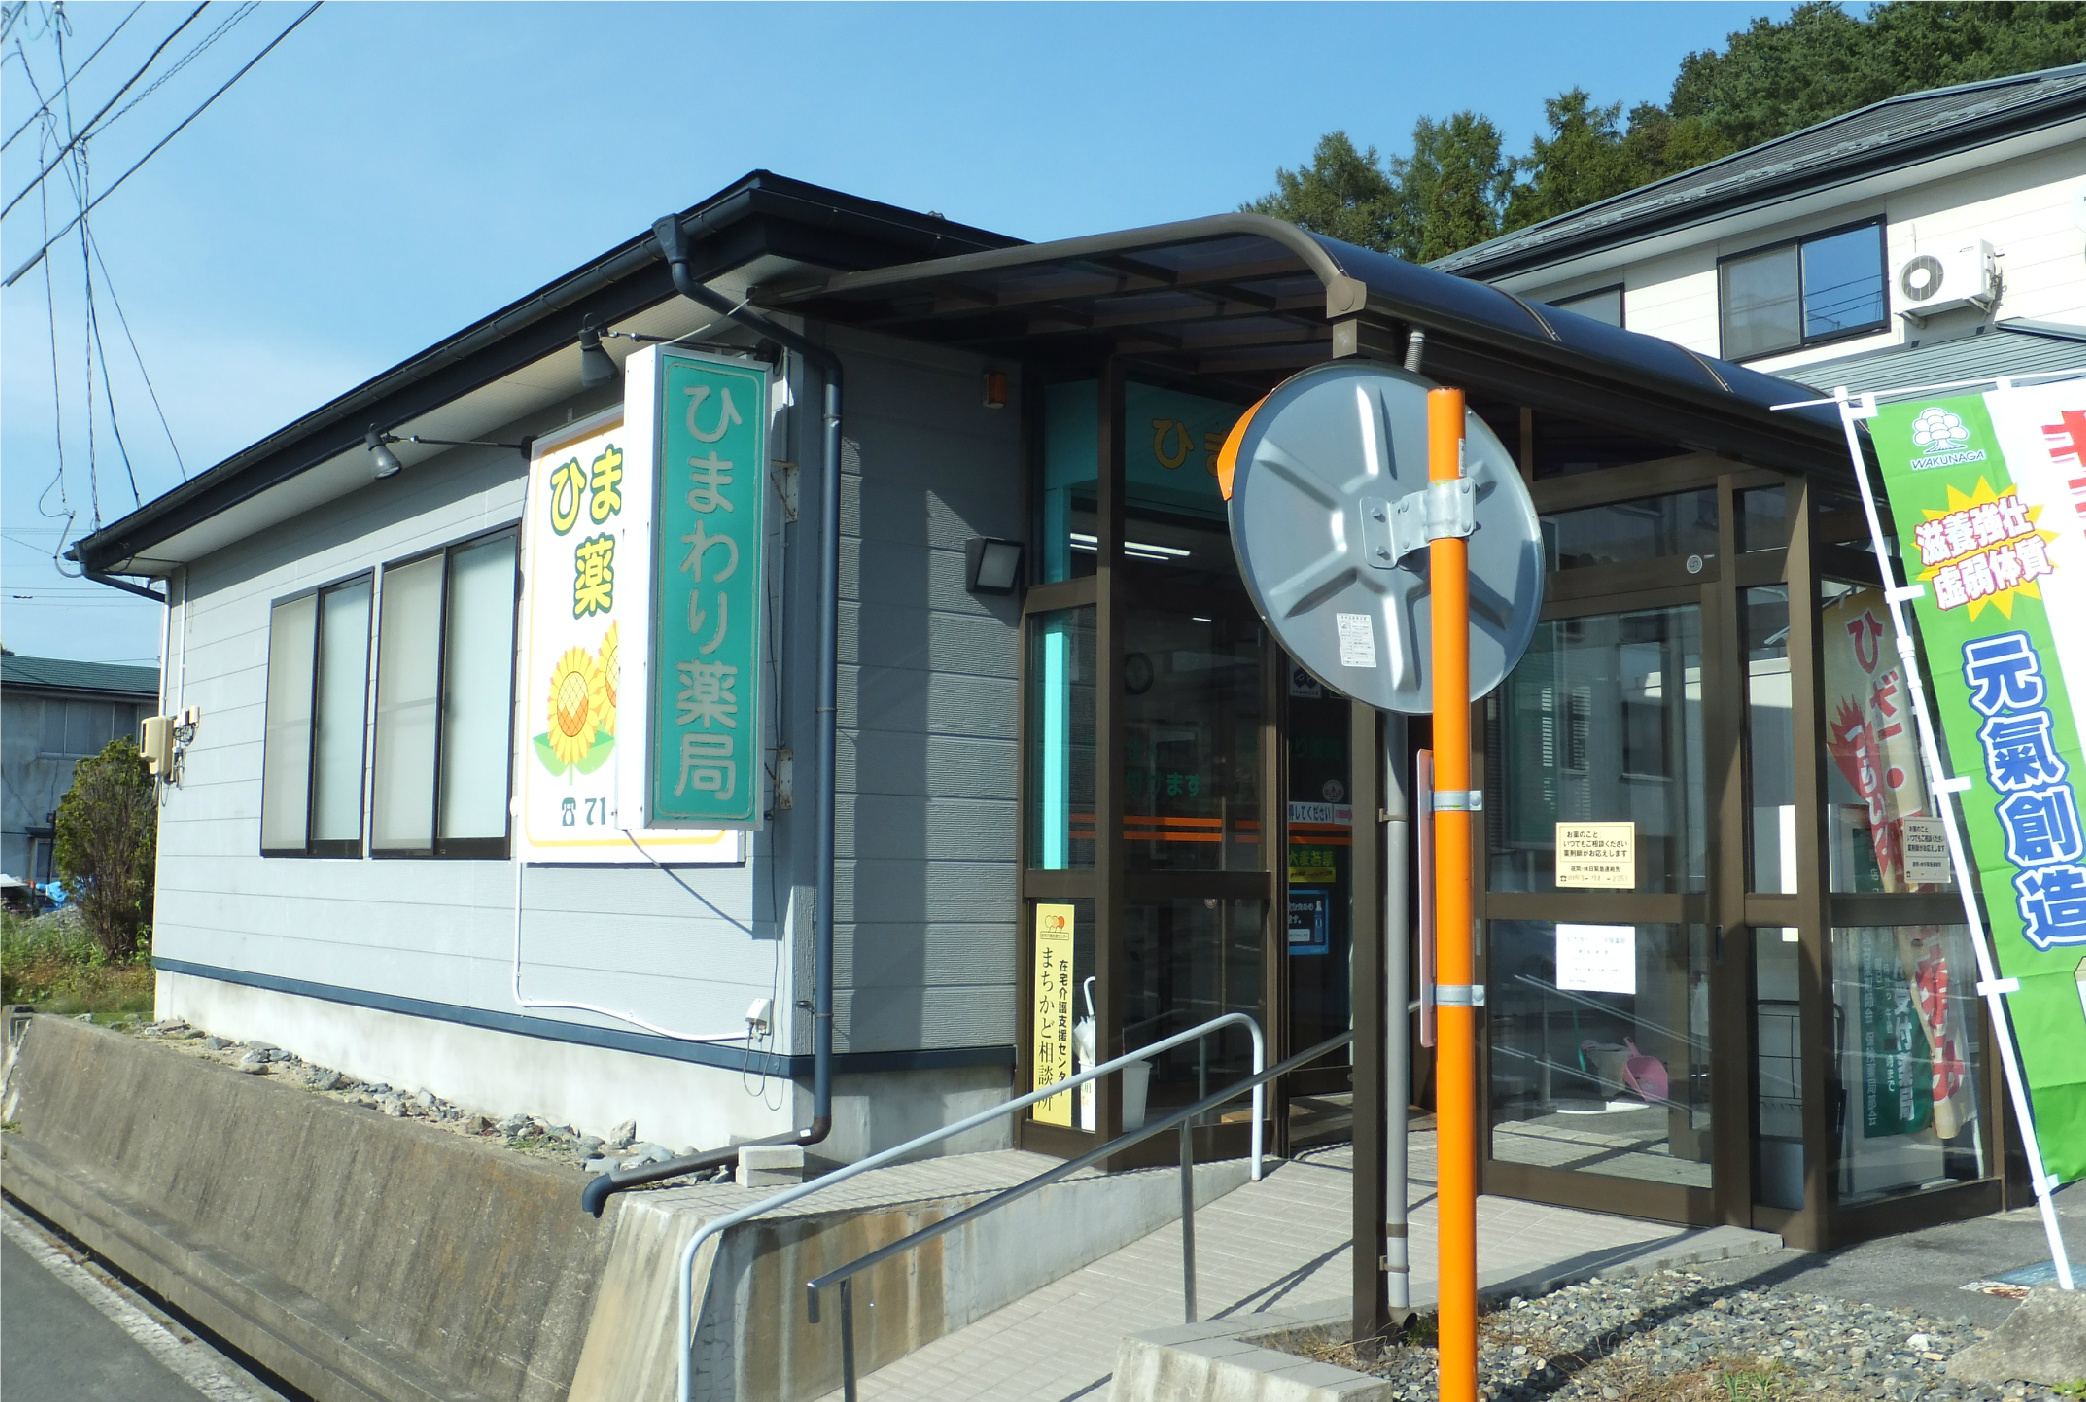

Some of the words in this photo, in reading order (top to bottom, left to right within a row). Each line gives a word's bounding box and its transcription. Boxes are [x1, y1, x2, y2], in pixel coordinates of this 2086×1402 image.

[1911, 450, 1985, 469] WAKUNAGA
[573, 532, 615, 620] 薬
[675, 385, 742, 800] ひまわり薬局
[1932, 534, 2054, 611] 虚弱体質
[1962, 630, 2086, 952] 元氣創造
[1037, 947, 1055, 1111] まちかど相談所
